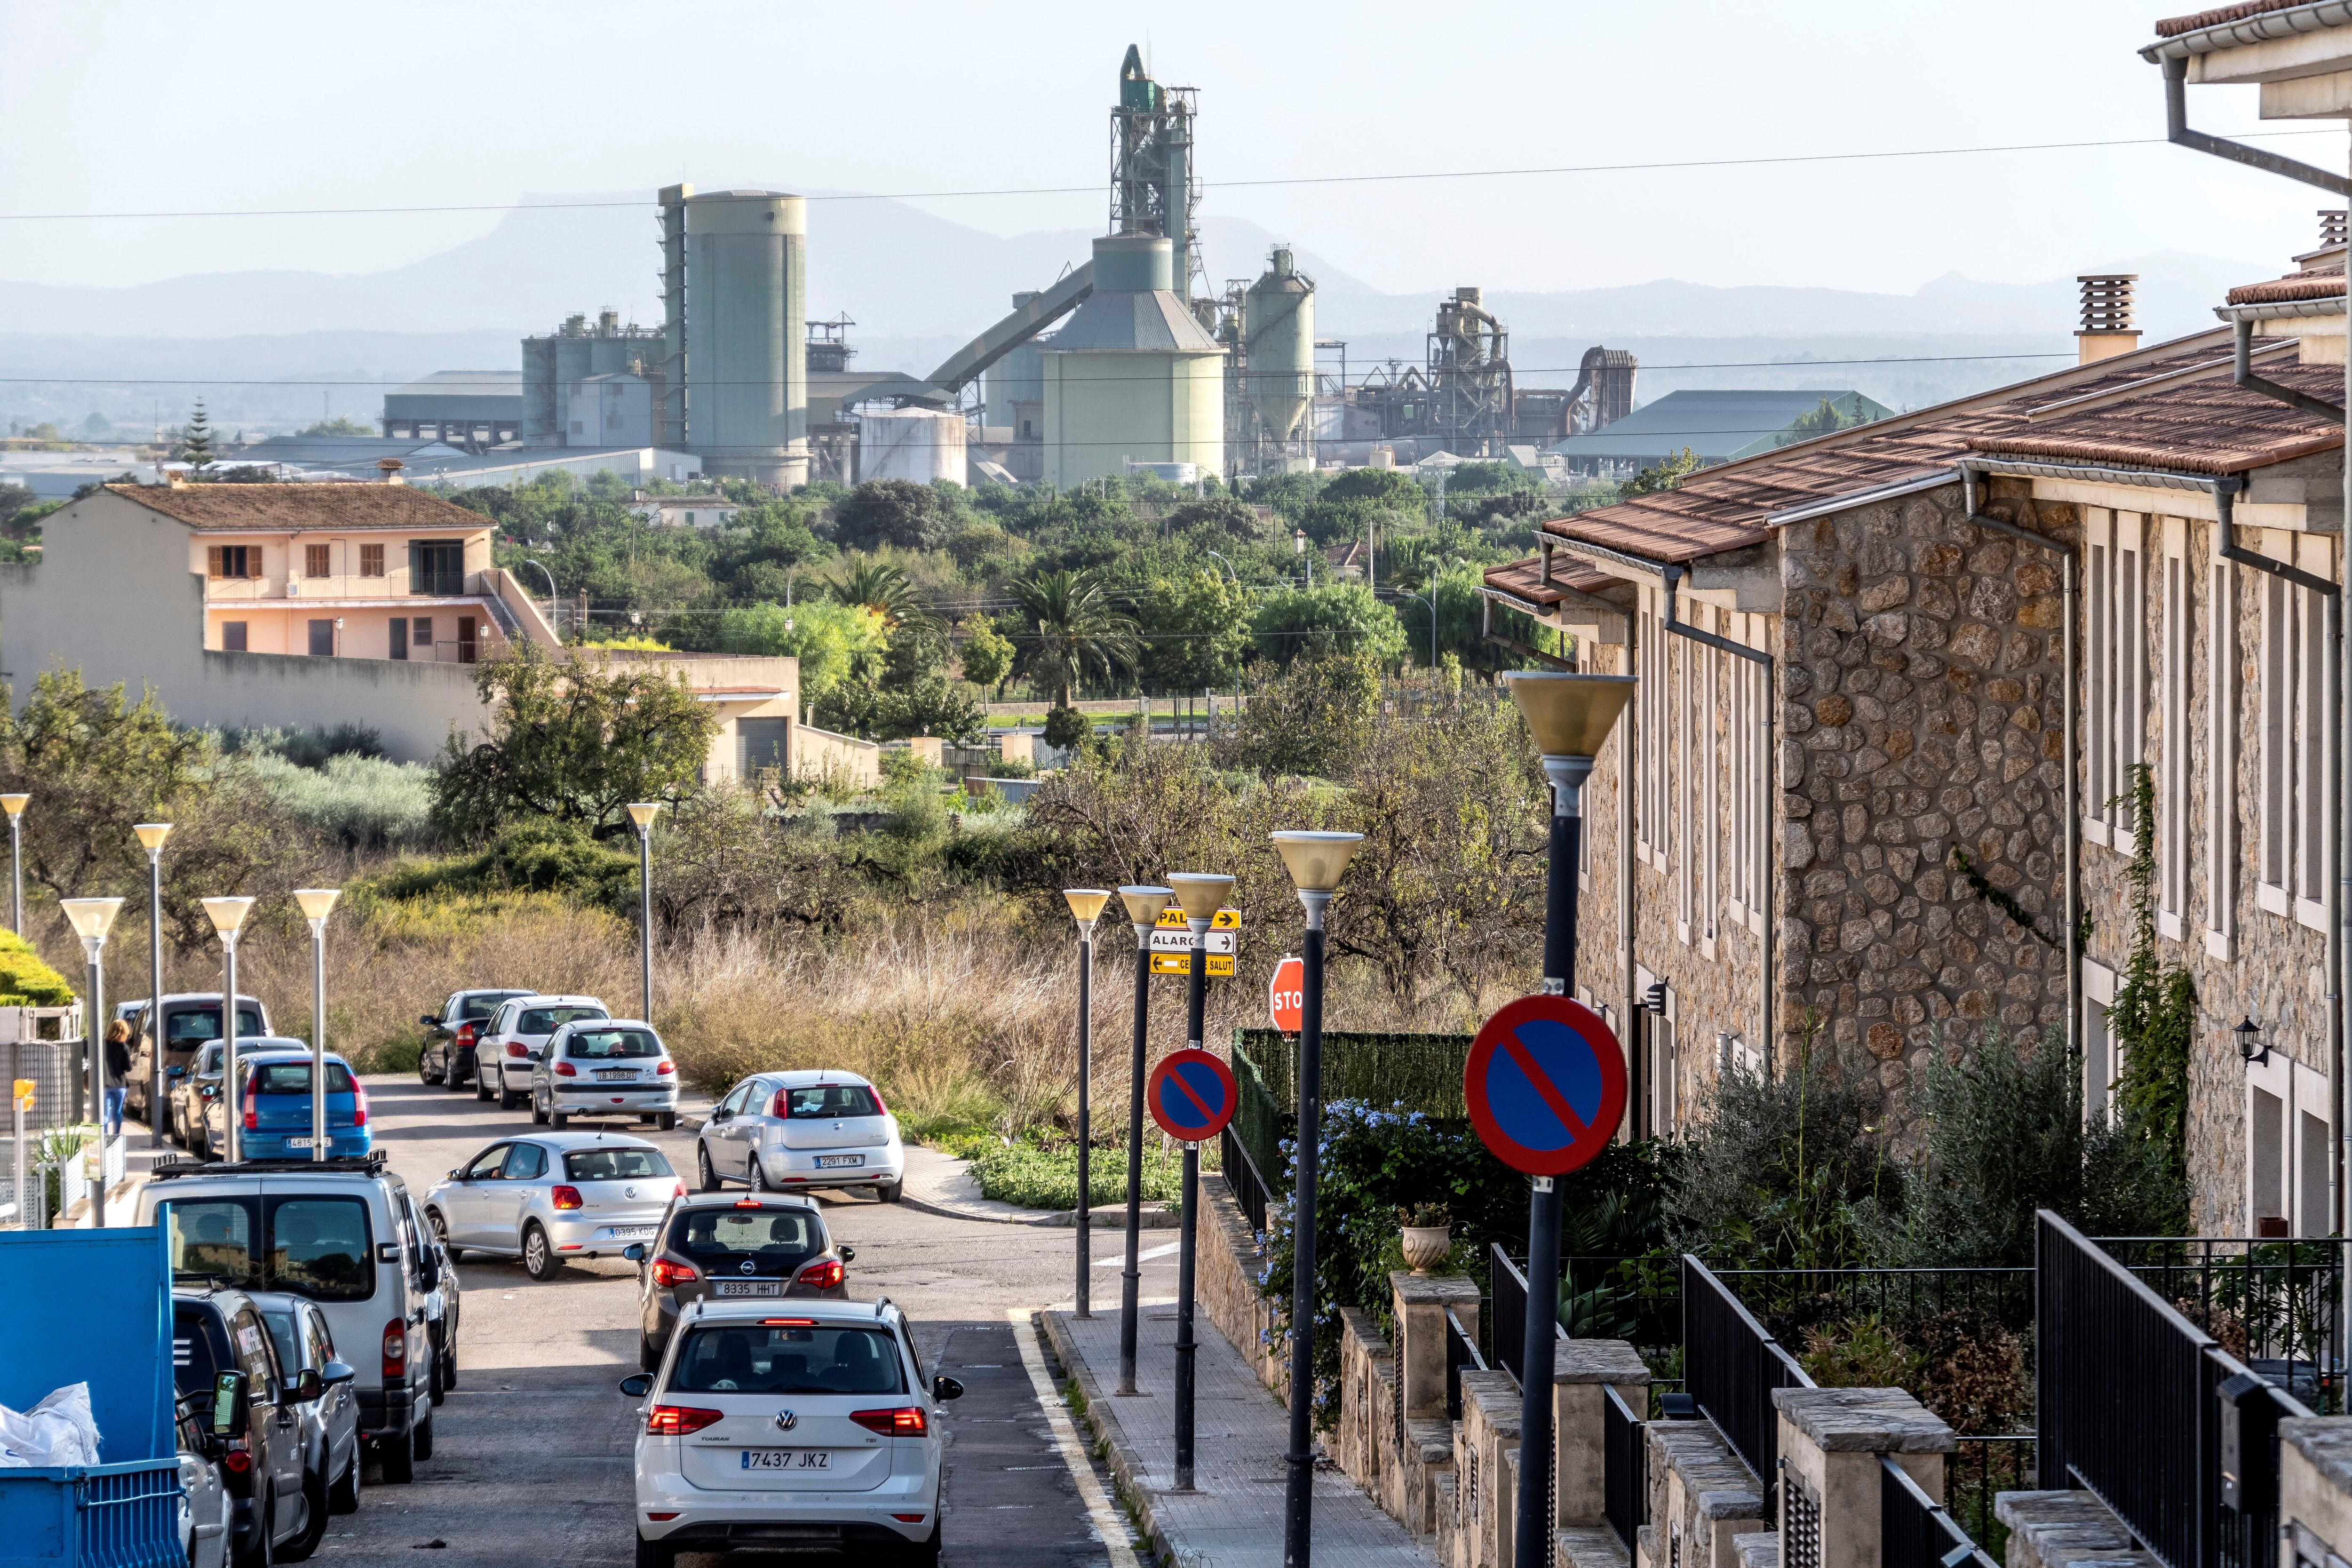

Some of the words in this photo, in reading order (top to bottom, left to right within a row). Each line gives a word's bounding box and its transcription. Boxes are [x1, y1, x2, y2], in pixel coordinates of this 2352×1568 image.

[1159, 913, 1187, 923] PAL
[1210, 961, 1232, 971] SALUT
[1274, 991, 1302, 1011] STO
[822, 1157, 840, 1166] 2291
[615, 1228, 636, 1236] 0395
[724, 1283, 749, 1294] 8335
[757, 1283, 776, 1294] HHT
[752, 1453, 791, 1467] 7437
[799, 1453, 827, 1467] JKZ
